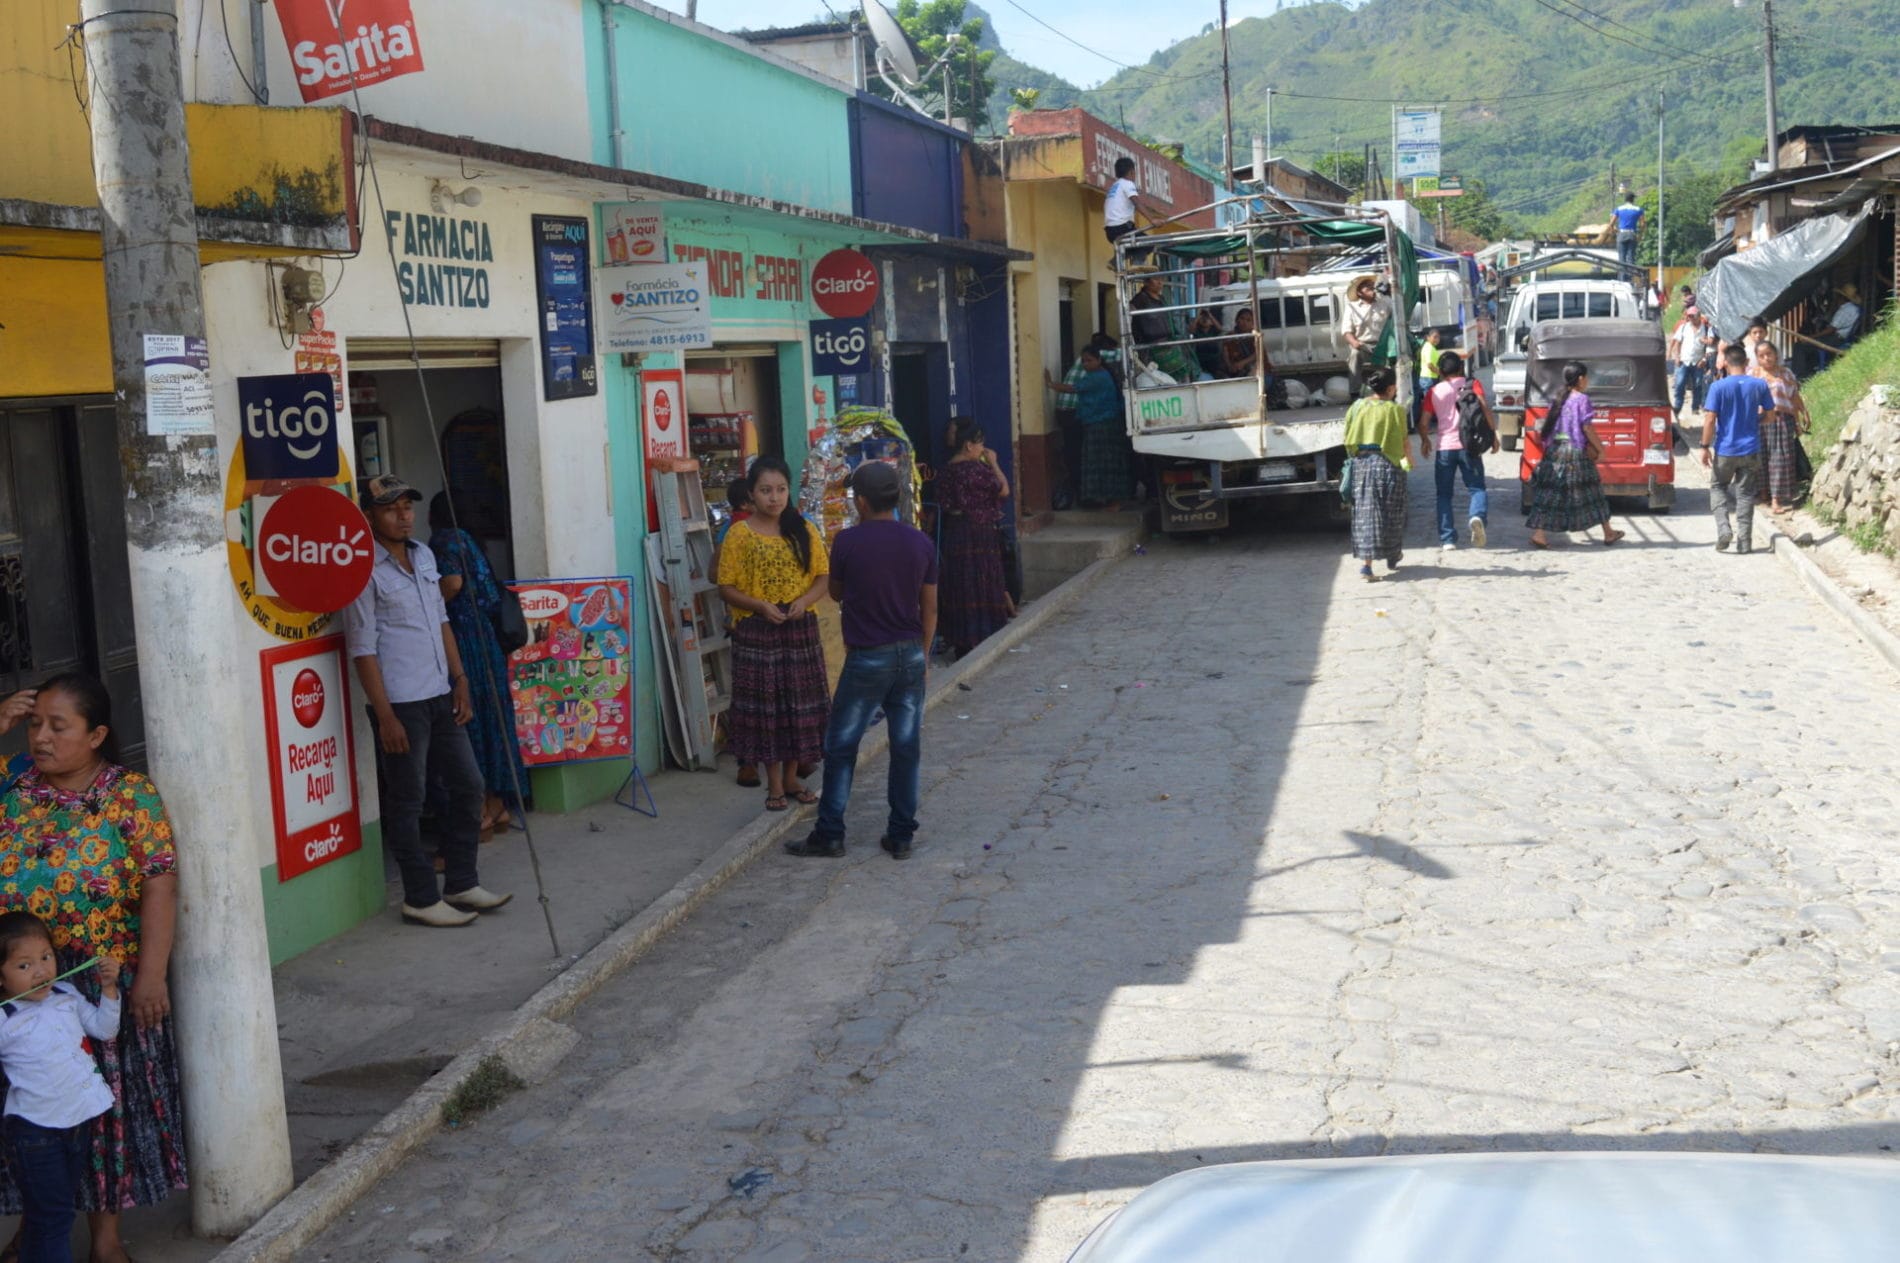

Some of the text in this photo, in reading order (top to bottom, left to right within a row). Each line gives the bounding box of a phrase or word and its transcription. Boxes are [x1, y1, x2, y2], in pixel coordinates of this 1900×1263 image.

[294, 22, 414, 86] Sarita
[629, 225, 657, 237] AQUÍ
[636, 216, 659, 224] VENTA
[386, 210, 494, 263] FARMACIA
[399, 261, 490, 309] SANTIZO
[815, 269, 875, 294] Claro
[625, 288, 699, 307] SANTIZO
[650, 333, 706, 346] 4815-6913
[814, 327, 866, 355] tigo
[246, 390, 329, 438] tigo
[655, 401, 671, 416] Claro
[1141, 396, 1183, 419] HINO
[266, 525, 369, 566] Claro
[240, 580, 251, 600] AH
[253, 604, 270, 628] QUE
[275, 622, 303, 640] BUENA
[519, 595, 559, 611] Sarita
[294, 683, 324, 708] Claro
[288, 735, 338, 774] Recarga
[307, 764, 335, 806] Aquí
[305, 824, 344, 862] Claro
